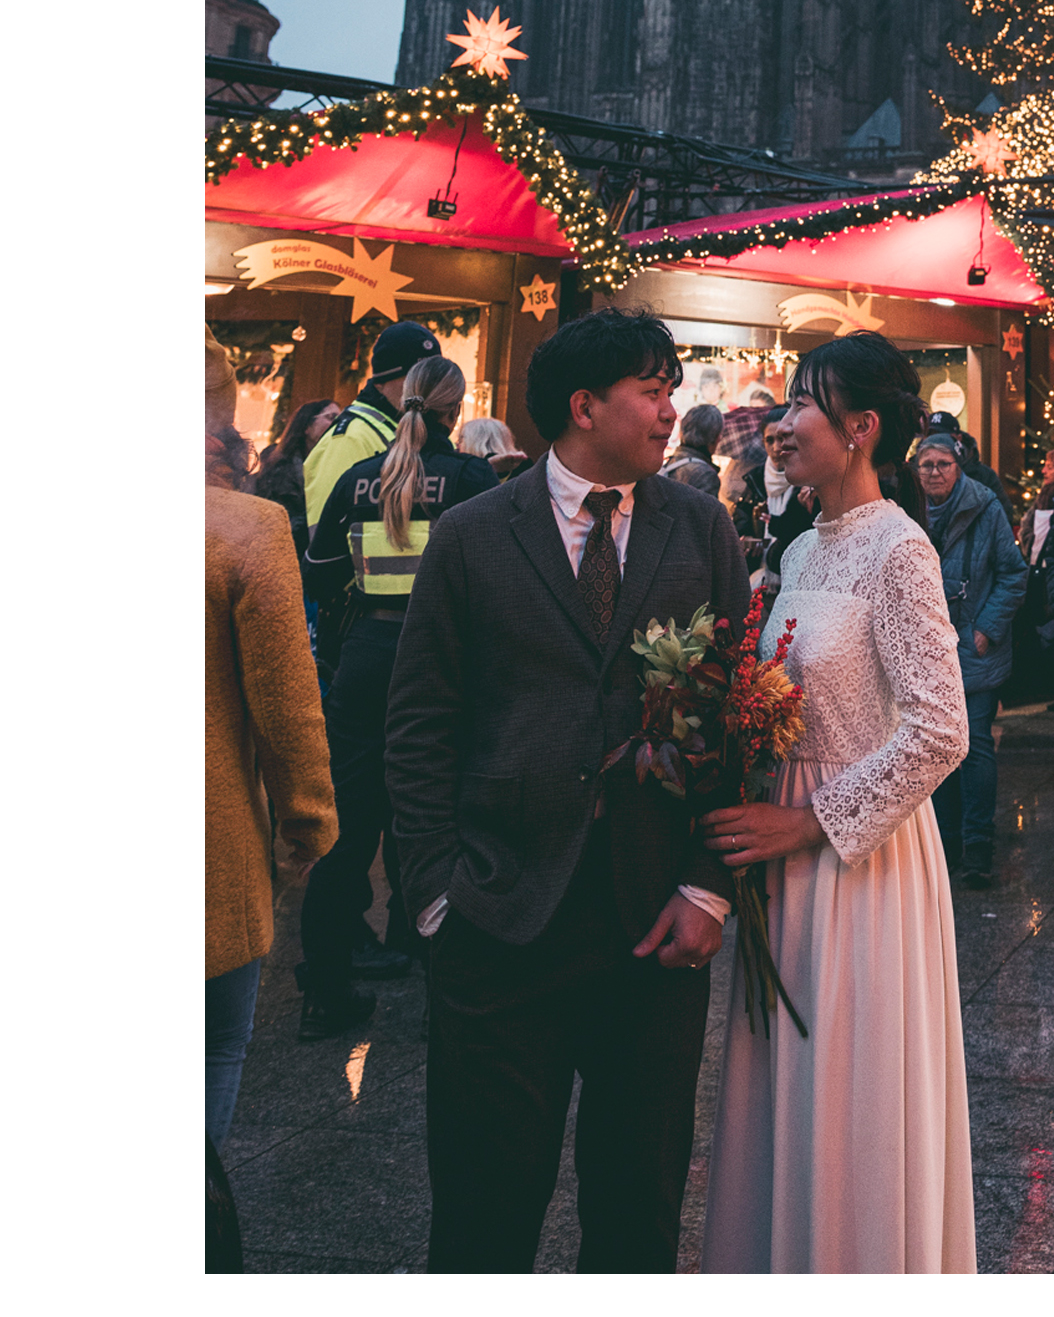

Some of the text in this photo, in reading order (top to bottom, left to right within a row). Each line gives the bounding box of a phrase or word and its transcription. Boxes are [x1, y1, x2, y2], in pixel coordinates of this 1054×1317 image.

[271, 244, 311, 253] domglas
[273, 257, 378, 289] Kölner Glasbläserei
[528, 290, 548, 306] 138
